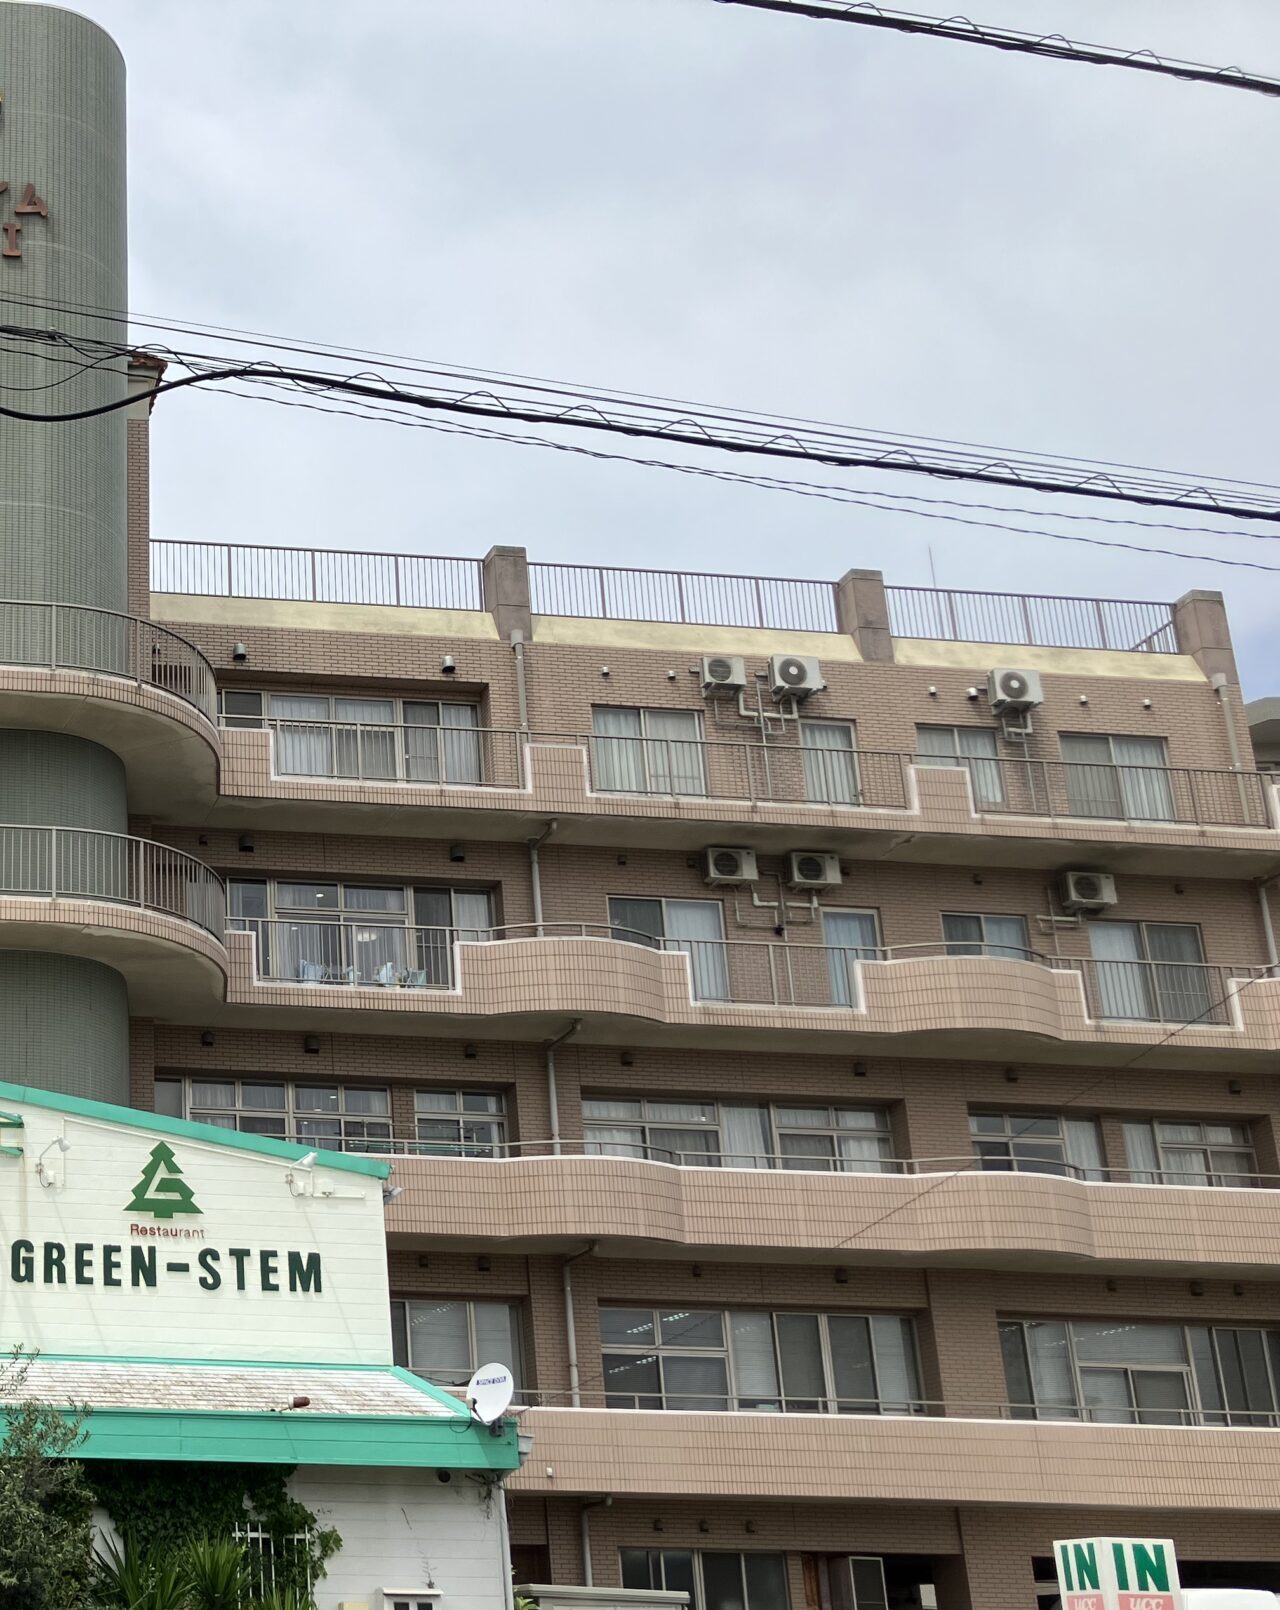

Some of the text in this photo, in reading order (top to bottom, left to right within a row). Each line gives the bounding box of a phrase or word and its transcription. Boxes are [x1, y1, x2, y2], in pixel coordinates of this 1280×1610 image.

[130, 1223, 205, 1239] Restaurant
[11, 1239, 322, 1292] GREEN-STEM
[1060, 1543, 1100, 1591] IN
[1112, 1543, 1170, 1592] IN
